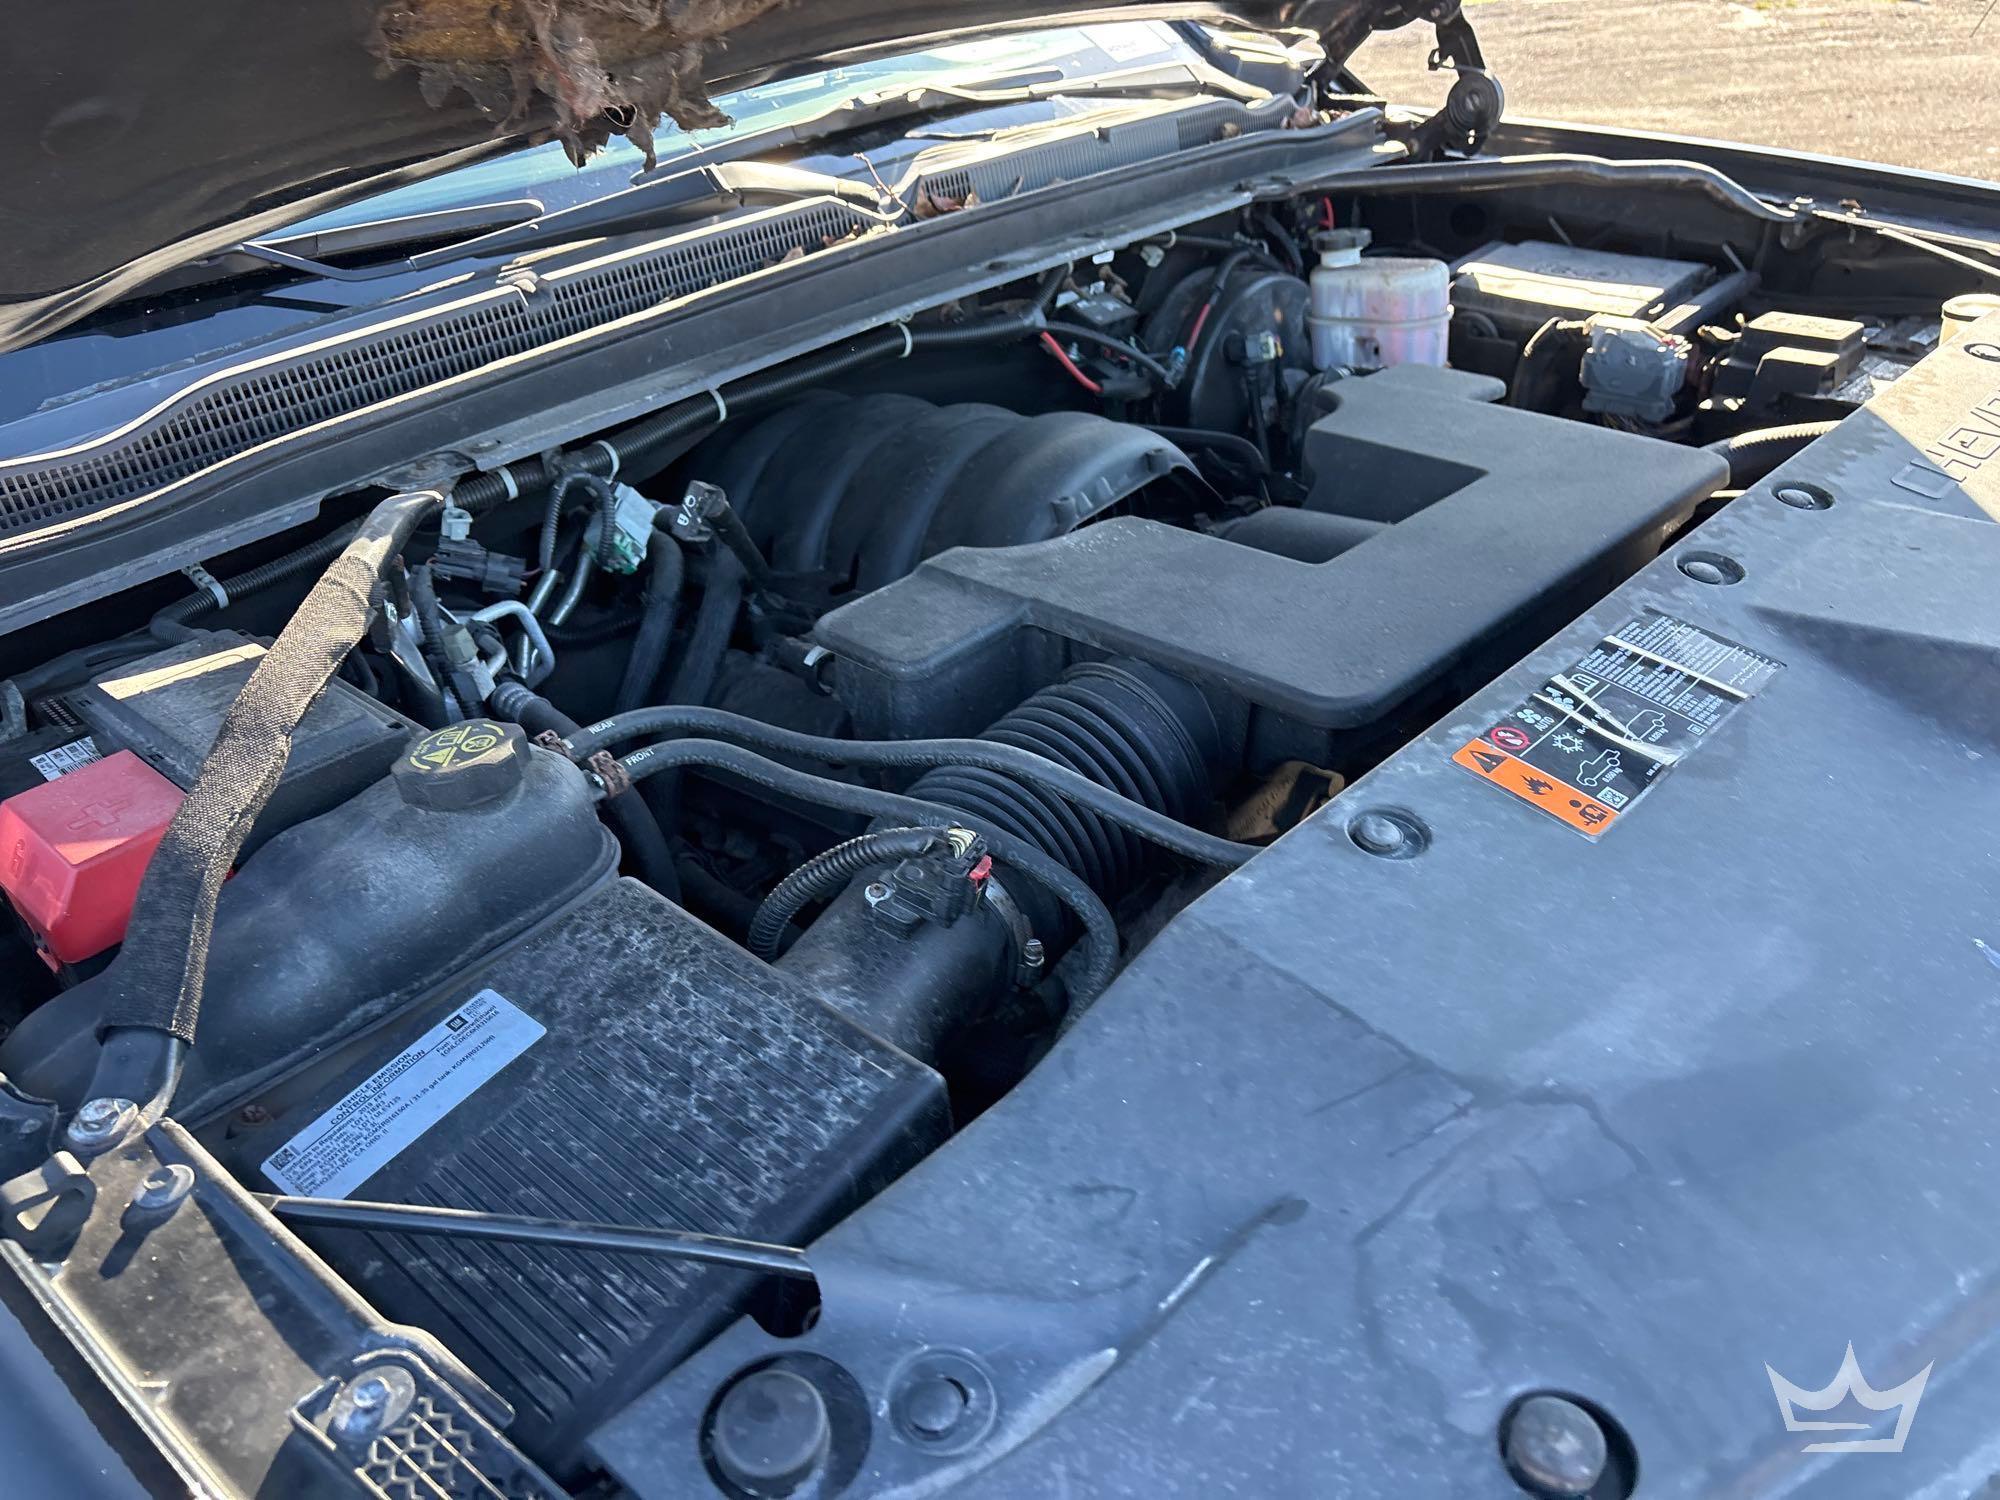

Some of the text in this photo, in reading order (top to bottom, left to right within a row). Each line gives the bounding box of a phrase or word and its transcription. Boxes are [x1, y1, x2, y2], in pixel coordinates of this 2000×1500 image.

[589, 721, 615, 735] REAR
[1534, 716, 1555, 732] AUTO
[625, 748, 655, 766] FRONT
[330, 1049, 426, 1125] CONTROL INFORMATION
[335, 1052, 412, 1112] VEHICLE EMISSION
